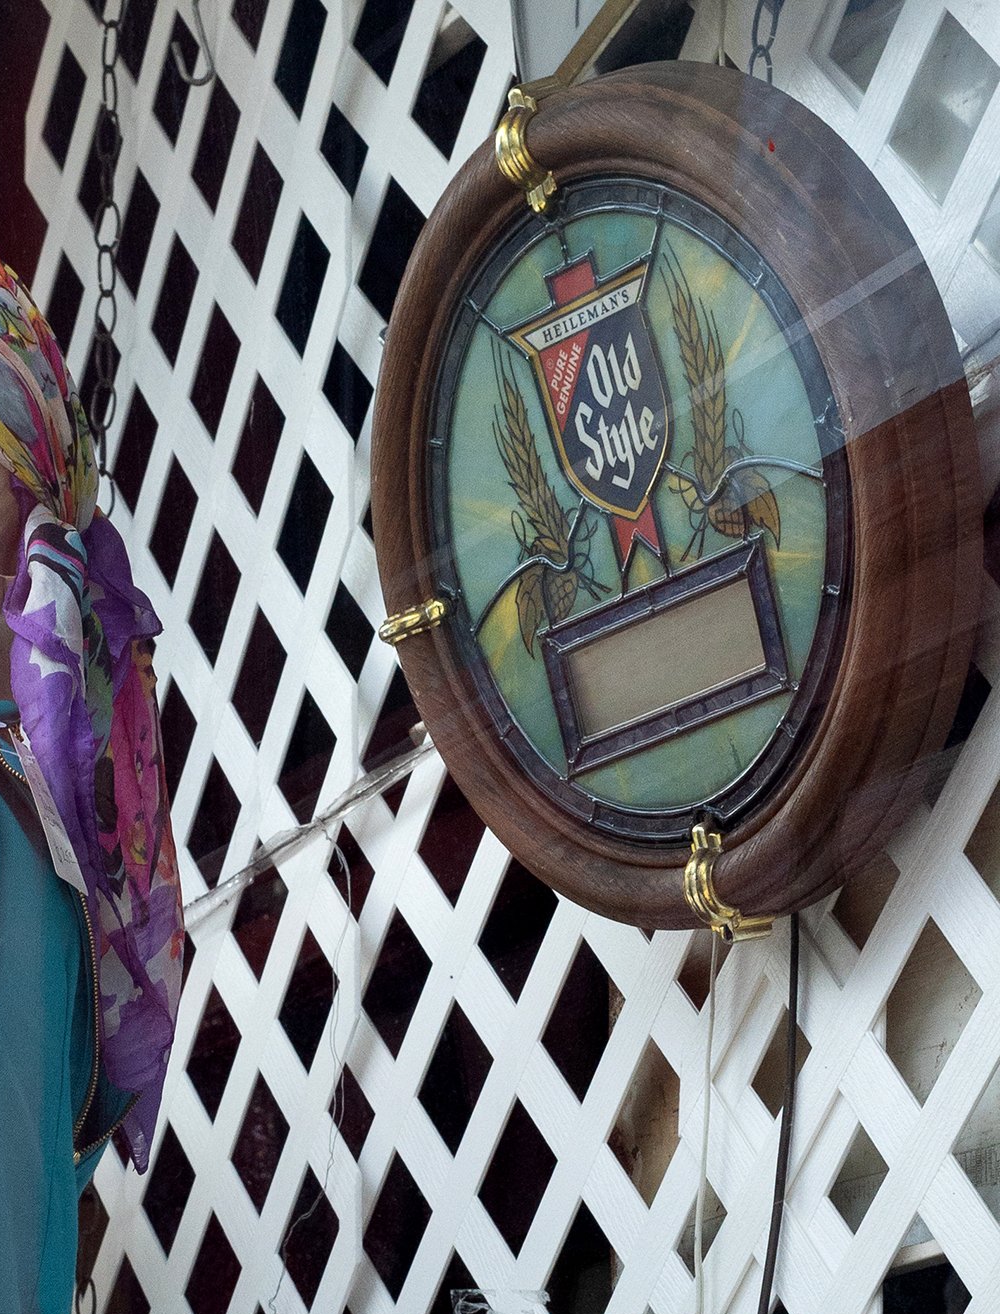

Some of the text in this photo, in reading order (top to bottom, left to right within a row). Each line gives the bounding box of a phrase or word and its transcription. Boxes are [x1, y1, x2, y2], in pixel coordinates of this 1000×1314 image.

[542, 289, 630, 344] HEILEMAN'S
[551, 349, 569, 391] PURE
[557, 342, 582, 415] GENUINE
[586, 331, 642, 409] Old
[574, 399, 659, 490] Style
